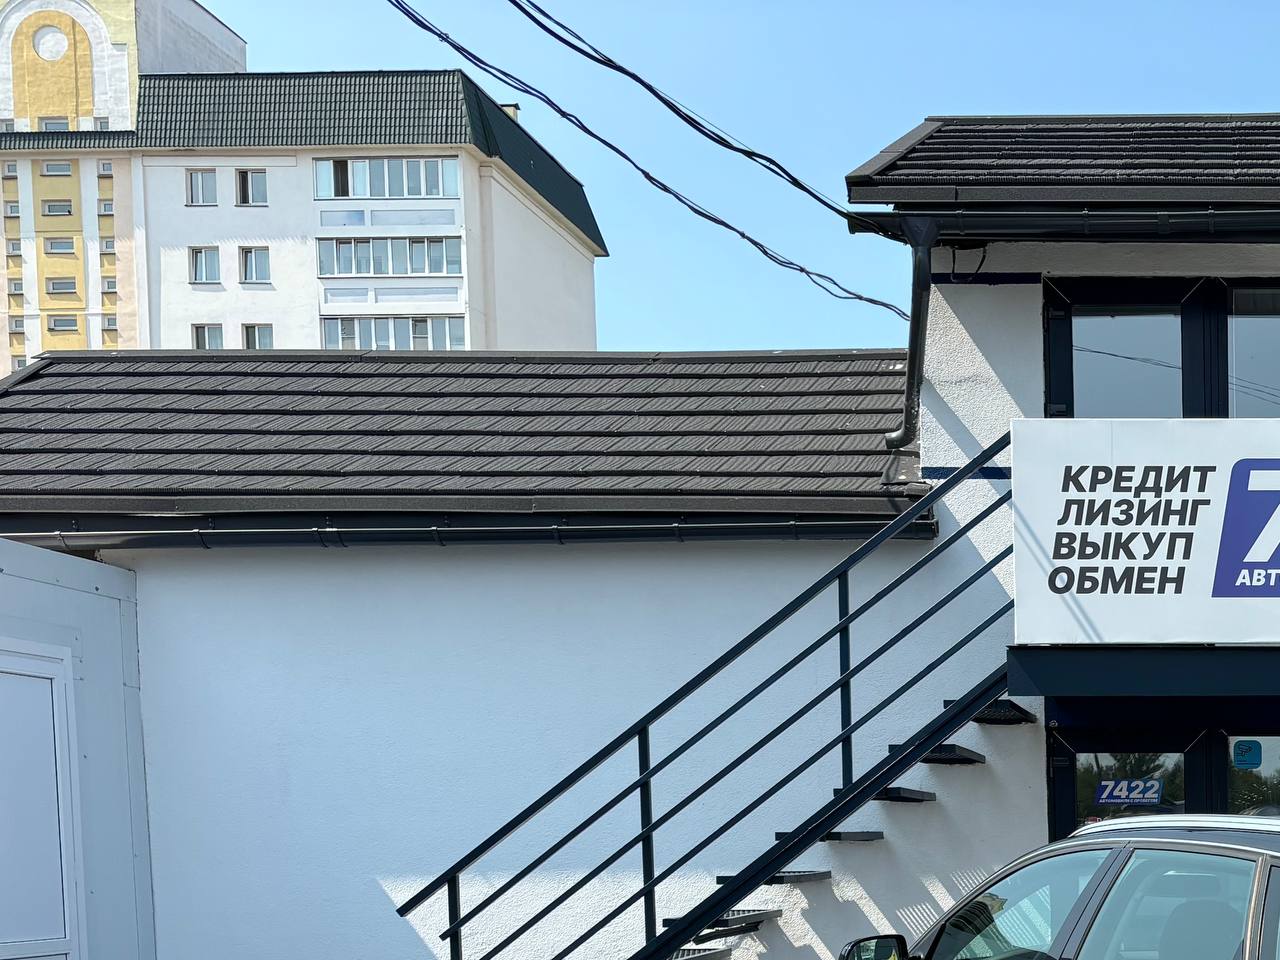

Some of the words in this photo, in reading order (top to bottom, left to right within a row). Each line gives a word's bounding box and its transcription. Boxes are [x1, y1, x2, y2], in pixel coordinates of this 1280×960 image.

[1061, 465, 1217, 498] КРЕДИТ
[1057, 499, 1211, 526] ЛИЗИНГ
[1052, 532, 1194, 560] ВЫКУП
[1048, 566, 1186, 594] ОБМЕН
[1101, 780, 1160, 799] 7422
